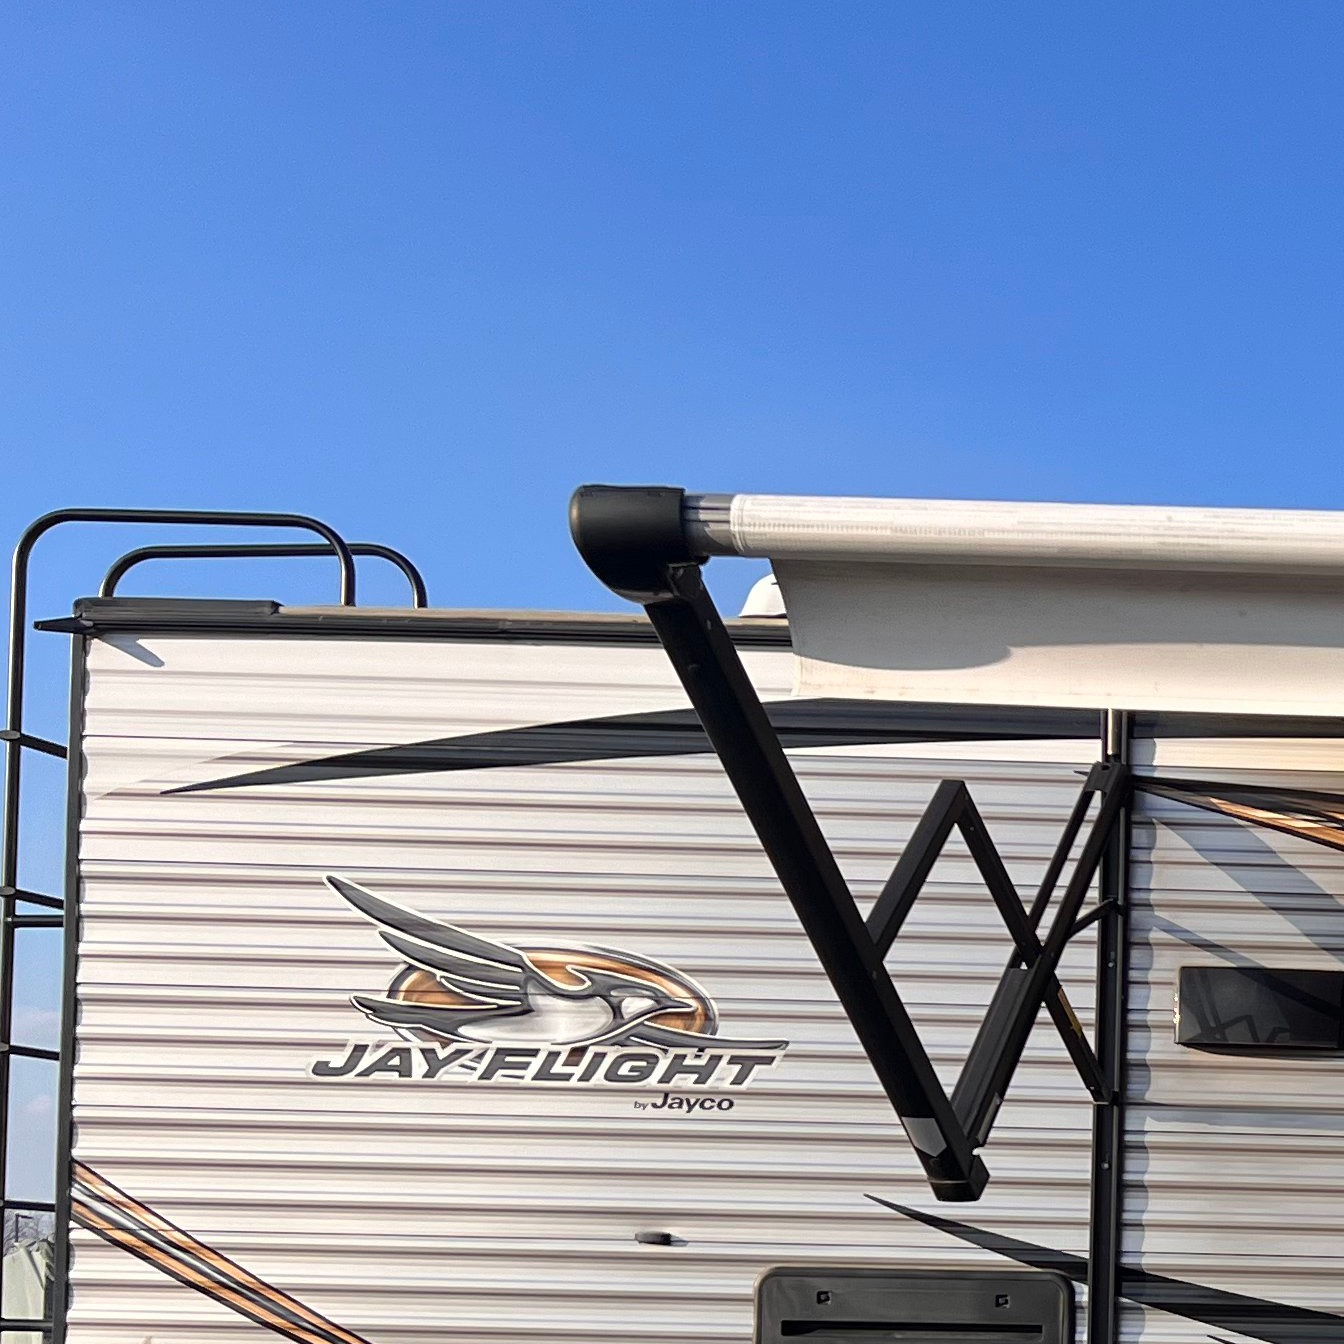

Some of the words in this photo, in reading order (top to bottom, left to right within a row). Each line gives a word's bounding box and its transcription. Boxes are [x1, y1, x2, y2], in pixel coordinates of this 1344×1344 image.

[312, 1043, 474, 1079] JAY
[481, 1045, 777, 1086] FLIGHT
[634, 1100, 649, 1111] by
[650, 1092, 735, 1114] Jayco
